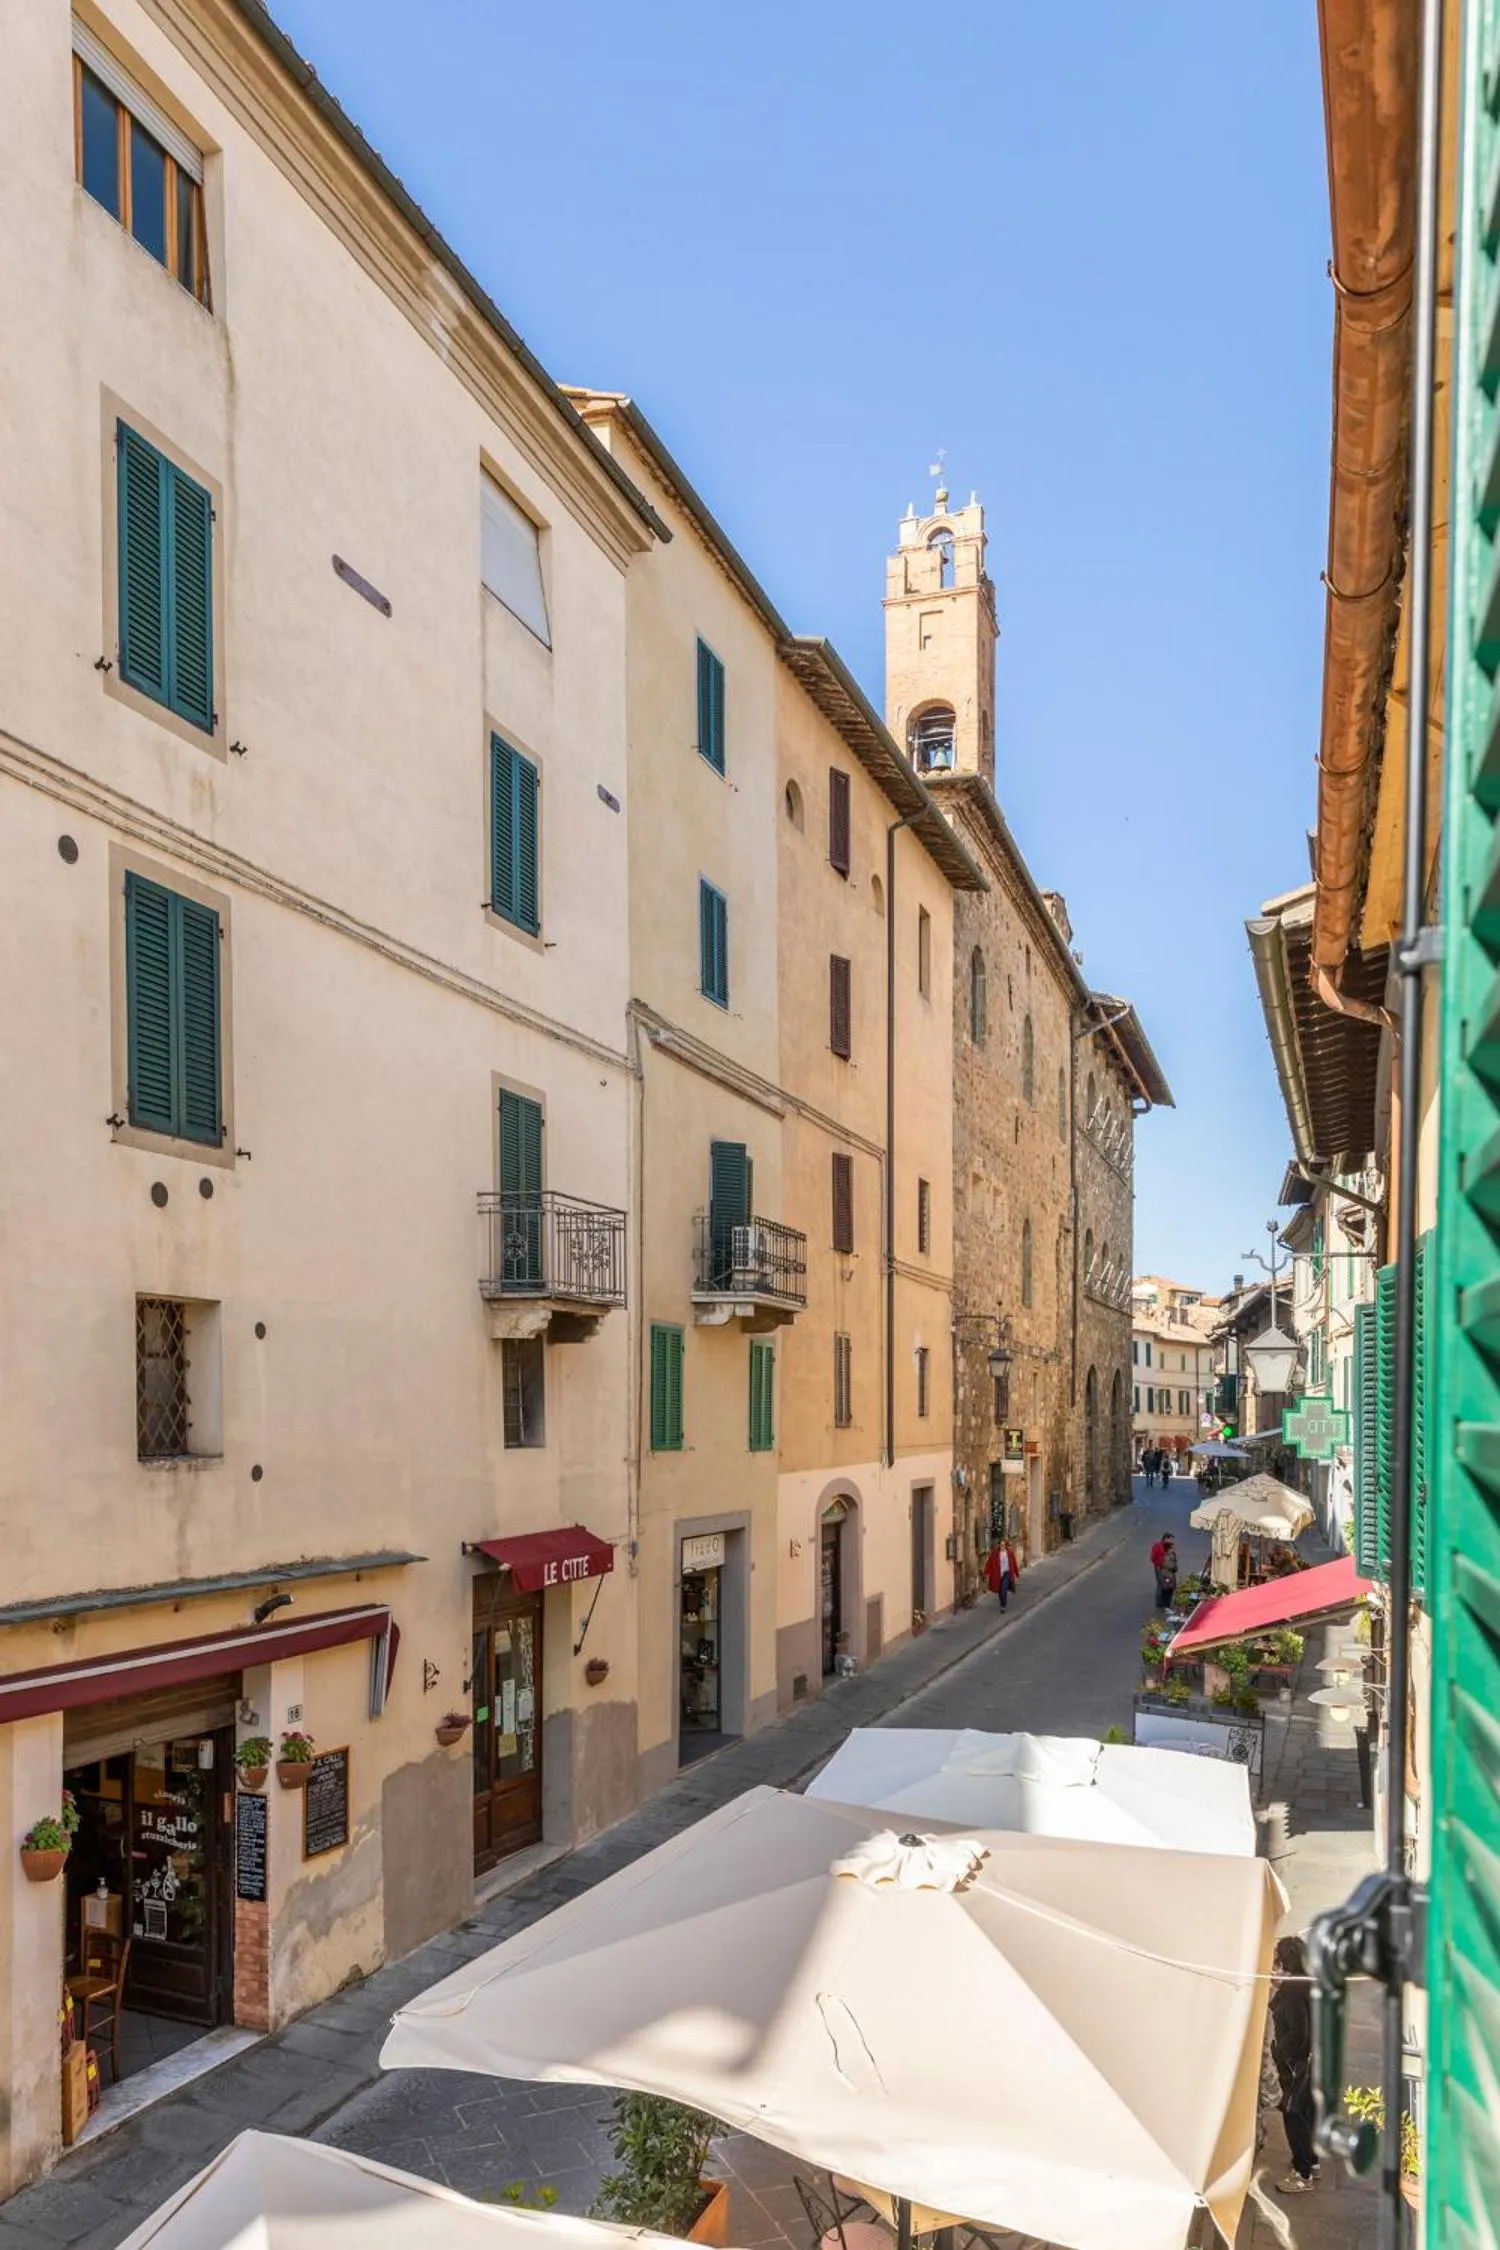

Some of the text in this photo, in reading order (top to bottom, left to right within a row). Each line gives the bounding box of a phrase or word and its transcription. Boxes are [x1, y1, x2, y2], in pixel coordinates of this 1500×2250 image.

[543, 1555, 590, 1587] LE CITTE
[141, 1810, 198, 1837] il gallo
